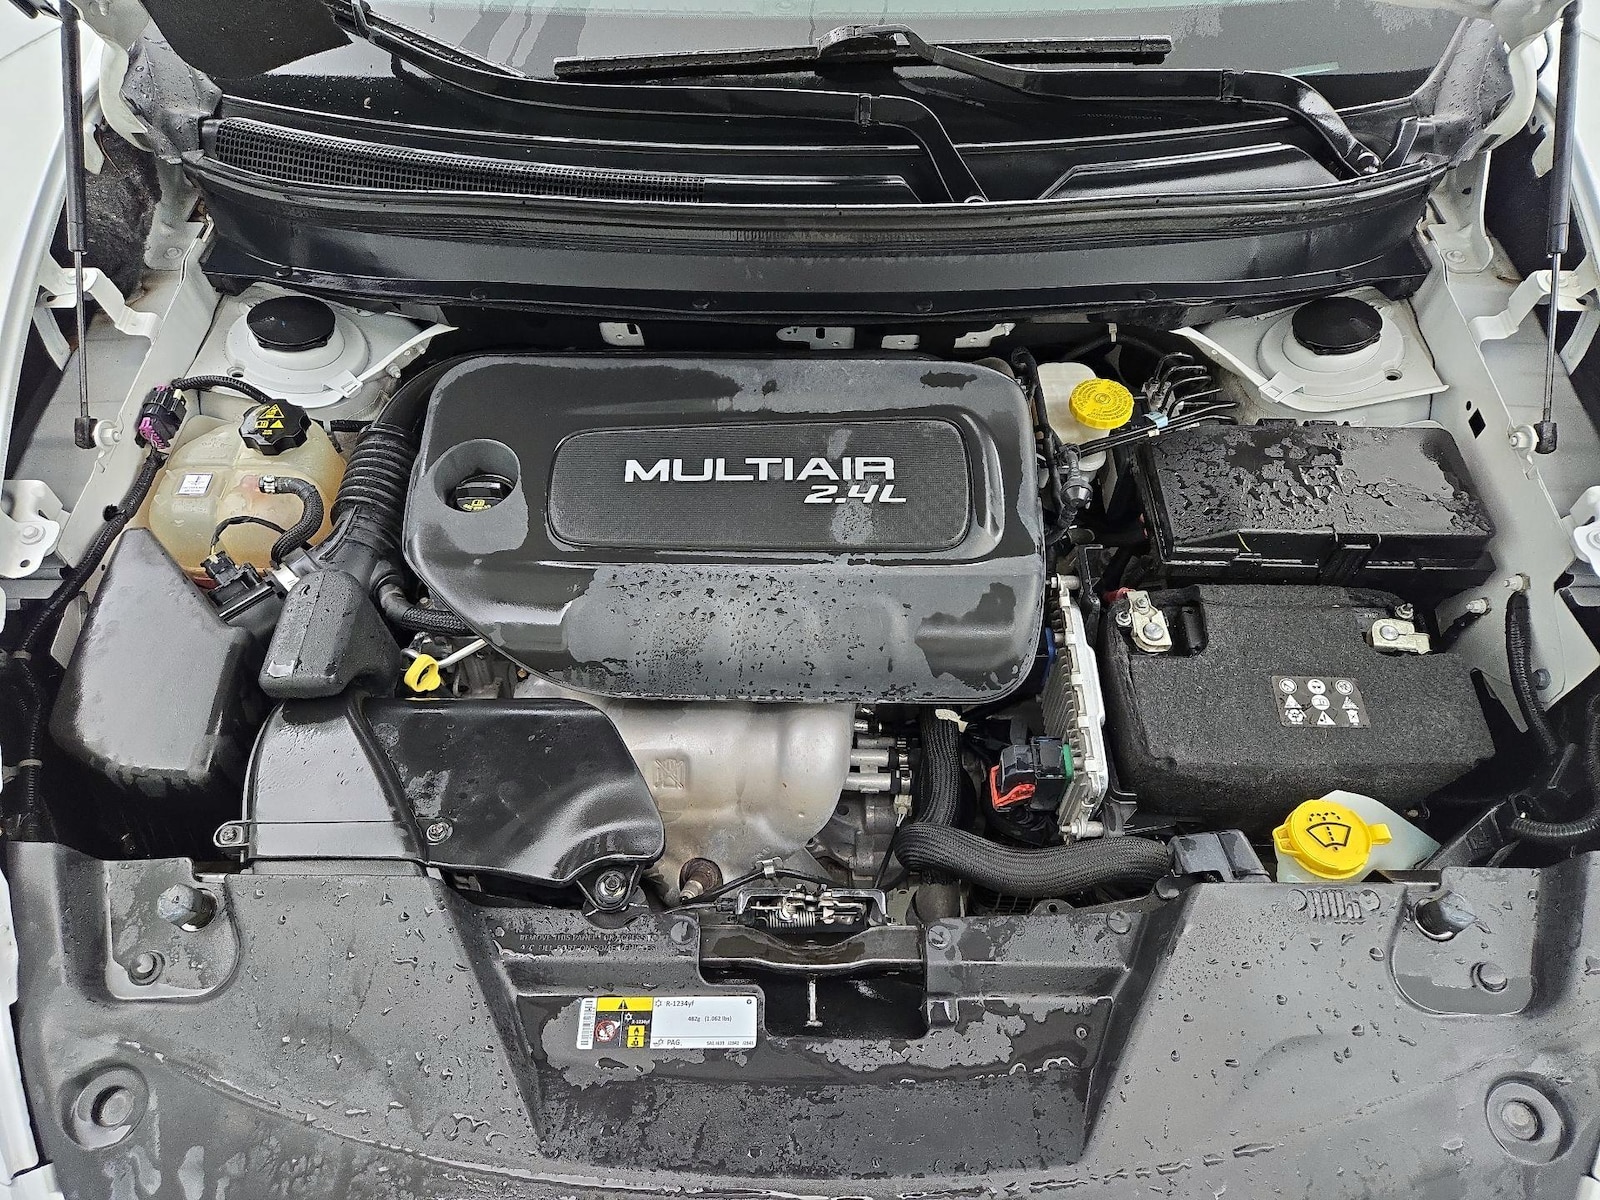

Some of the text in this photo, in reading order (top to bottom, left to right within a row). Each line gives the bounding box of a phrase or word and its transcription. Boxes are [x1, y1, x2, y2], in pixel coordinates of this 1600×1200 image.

[624, 457, 895, 482] MULTIAIR
[803, 484, 907, 504] 2.4L
[666, 1000, 694, 1008] R-1234yf
